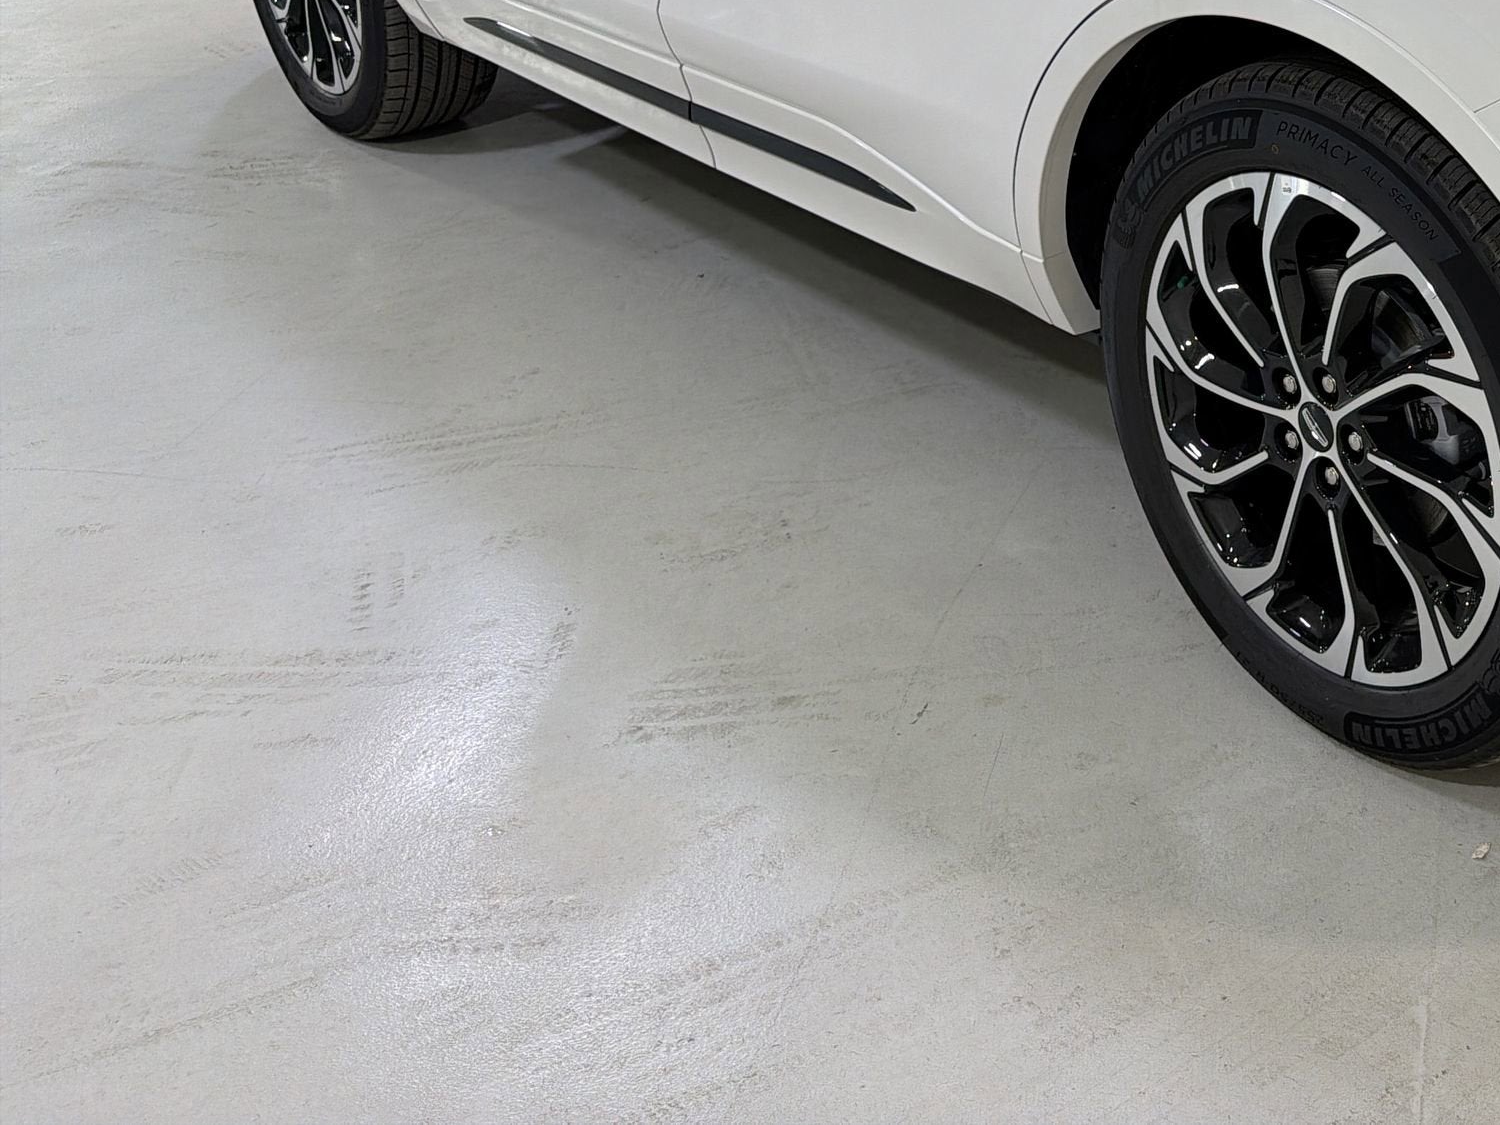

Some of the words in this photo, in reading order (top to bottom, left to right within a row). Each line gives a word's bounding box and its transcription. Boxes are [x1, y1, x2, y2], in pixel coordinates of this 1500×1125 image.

[1136, 116, 1254, 201] MICHELIN
[1276, 120, 1358, 168] PRIMACY
[1361, 164, 1384, 189] ALL
[1388, 187, 1439, 242] SEASON
[1351, 693, 1493, 749] MICHELIN
